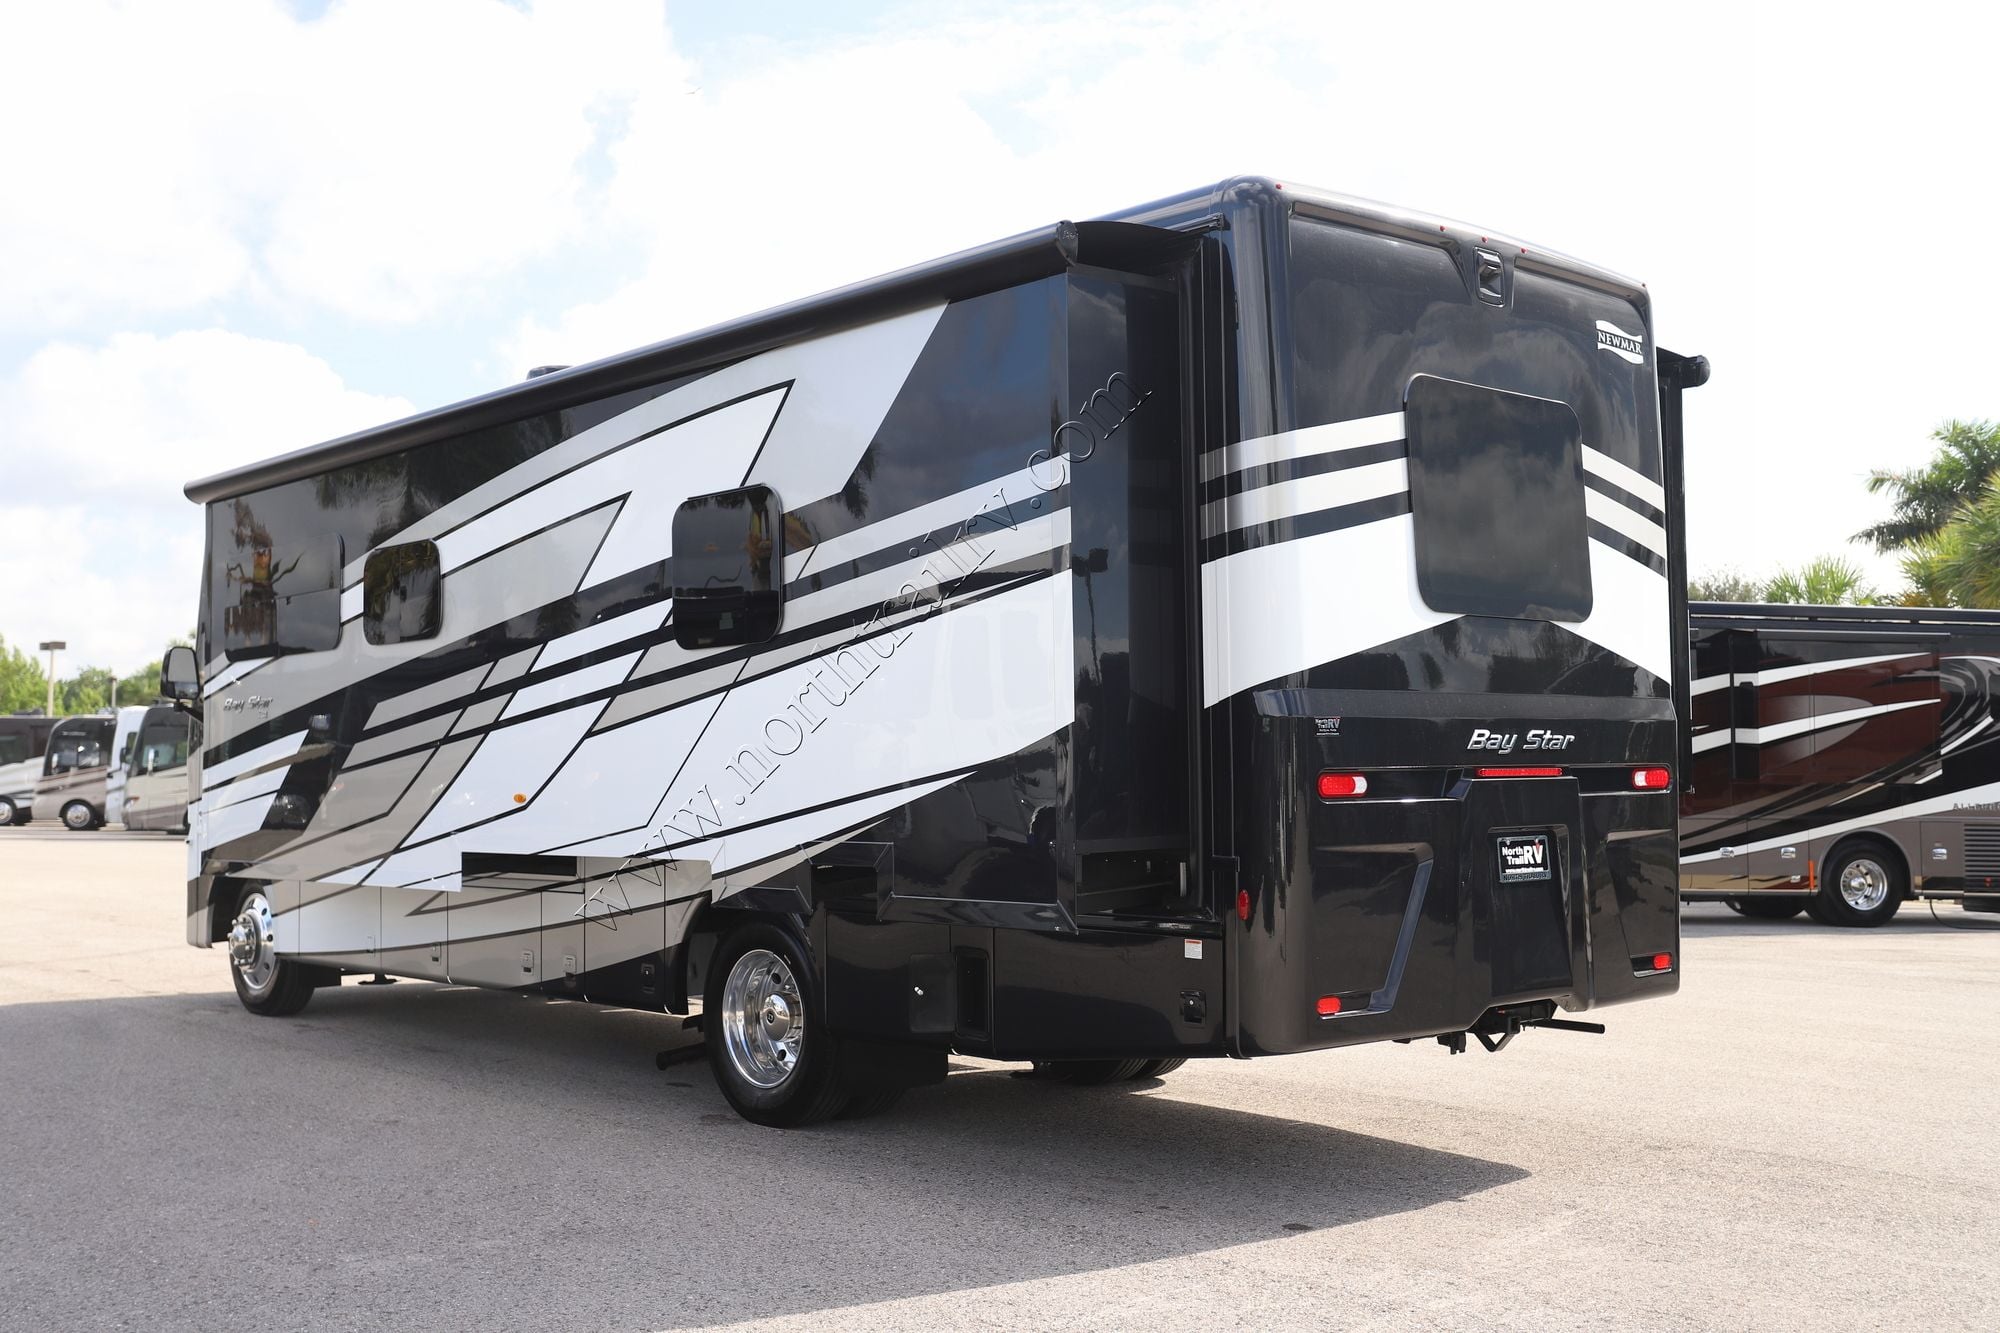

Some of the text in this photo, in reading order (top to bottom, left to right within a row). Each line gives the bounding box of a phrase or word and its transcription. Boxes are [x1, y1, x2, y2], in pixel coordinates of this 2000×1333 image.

[1597, 330, 1642, 355] NEWMAR
[223, 697, 246, 714] Bay
[1327, 718, 1341, 729] RV
[1467, 728, 1575, 755] Bay Star
[1501, 846, 1524, 856] North
[1523, 845, 1543, 865] RV
[1506, 855, 1524, 865] Trail
